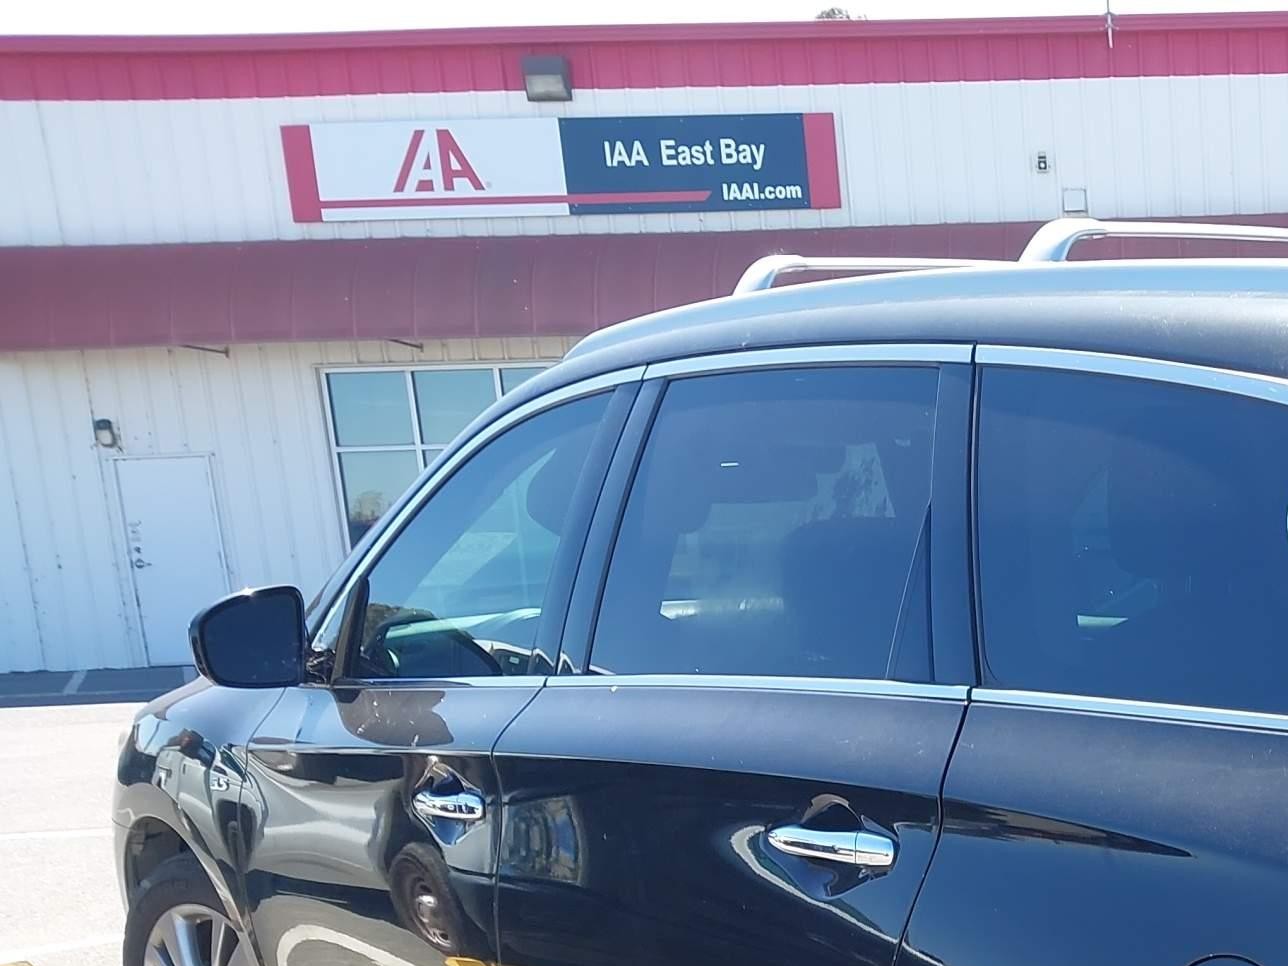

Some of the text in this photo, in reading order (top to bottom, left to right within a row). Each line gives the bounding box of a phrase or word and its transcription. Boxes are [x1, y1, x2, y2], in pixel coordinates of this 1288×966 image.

[604, 138, 765, 170] IAA East Bay
[722, 183, 802, 201] IAAI.com
